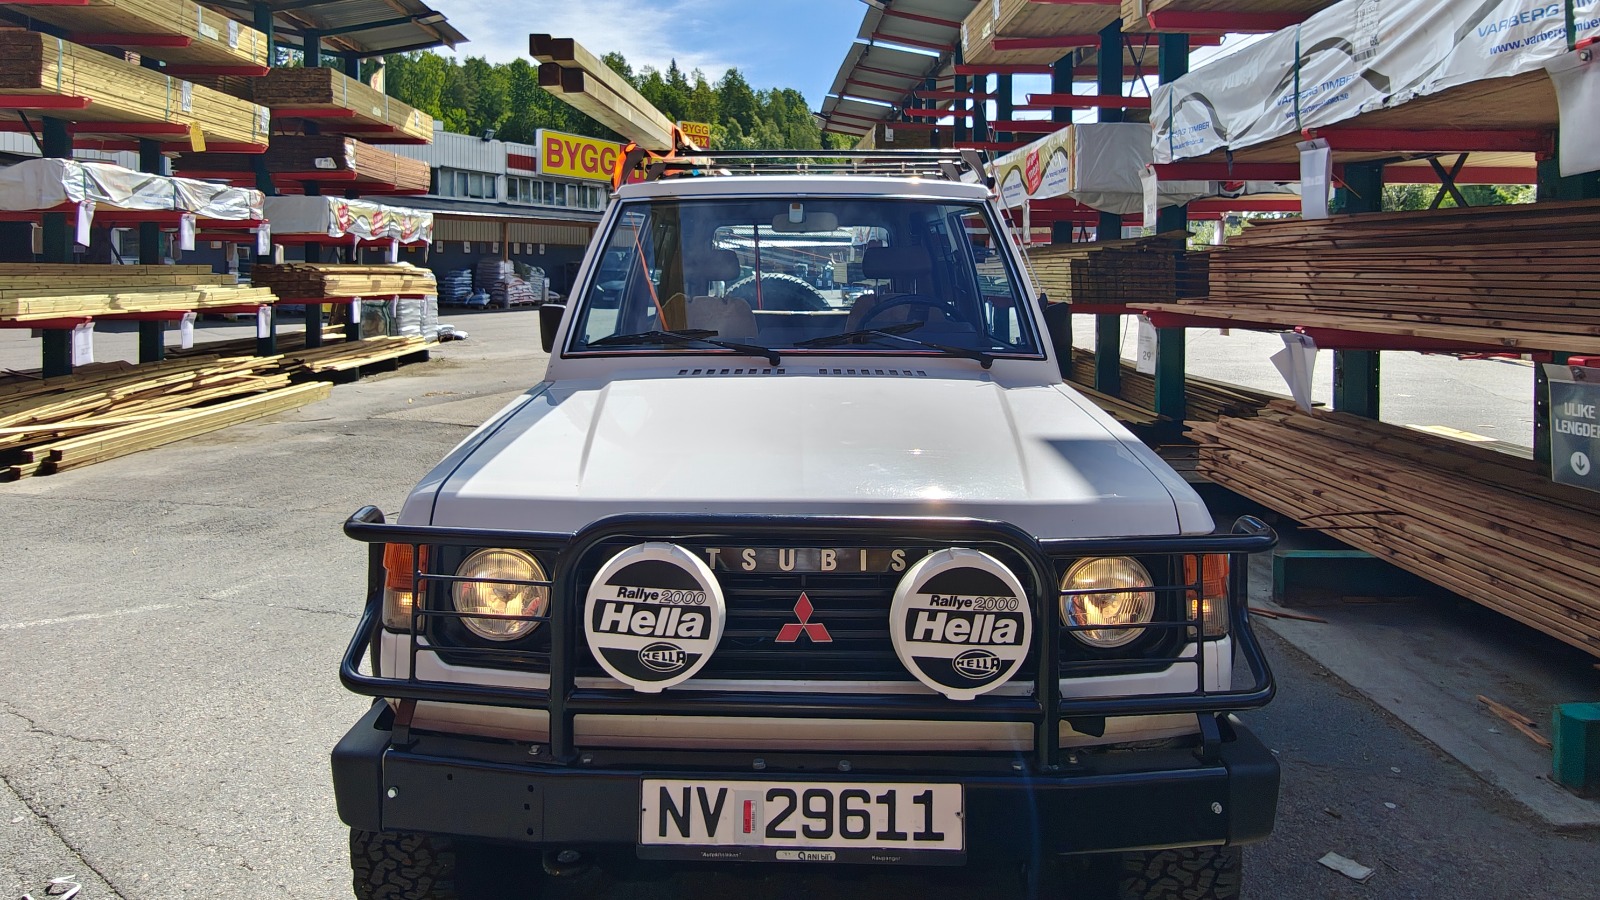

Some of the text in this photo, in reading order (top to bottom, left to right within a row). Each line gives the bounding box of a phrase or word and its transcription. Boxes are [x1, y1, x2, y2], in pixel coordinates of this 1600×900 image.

[1478, 4, 1560, 37] VARBERG
[682, 123, 709, 135] BYGG
[546, 137, 617, 175] BYGG
[1564, 402, 1596, 419] ULIKE
[705, 548, 907, 572] TSUBIS
[617, 586, 707, 605] Rallye 2000
[929, 594, 1019, 612] Rallye 2000
[599, 602, 705, 638] Hella
[912, 611, 1018, 644] Hella
[642, 650, 686, 664] HELLA
[956, 657, 1000, 671] HELLA
[658, 786, 945, 842] NV 29611
